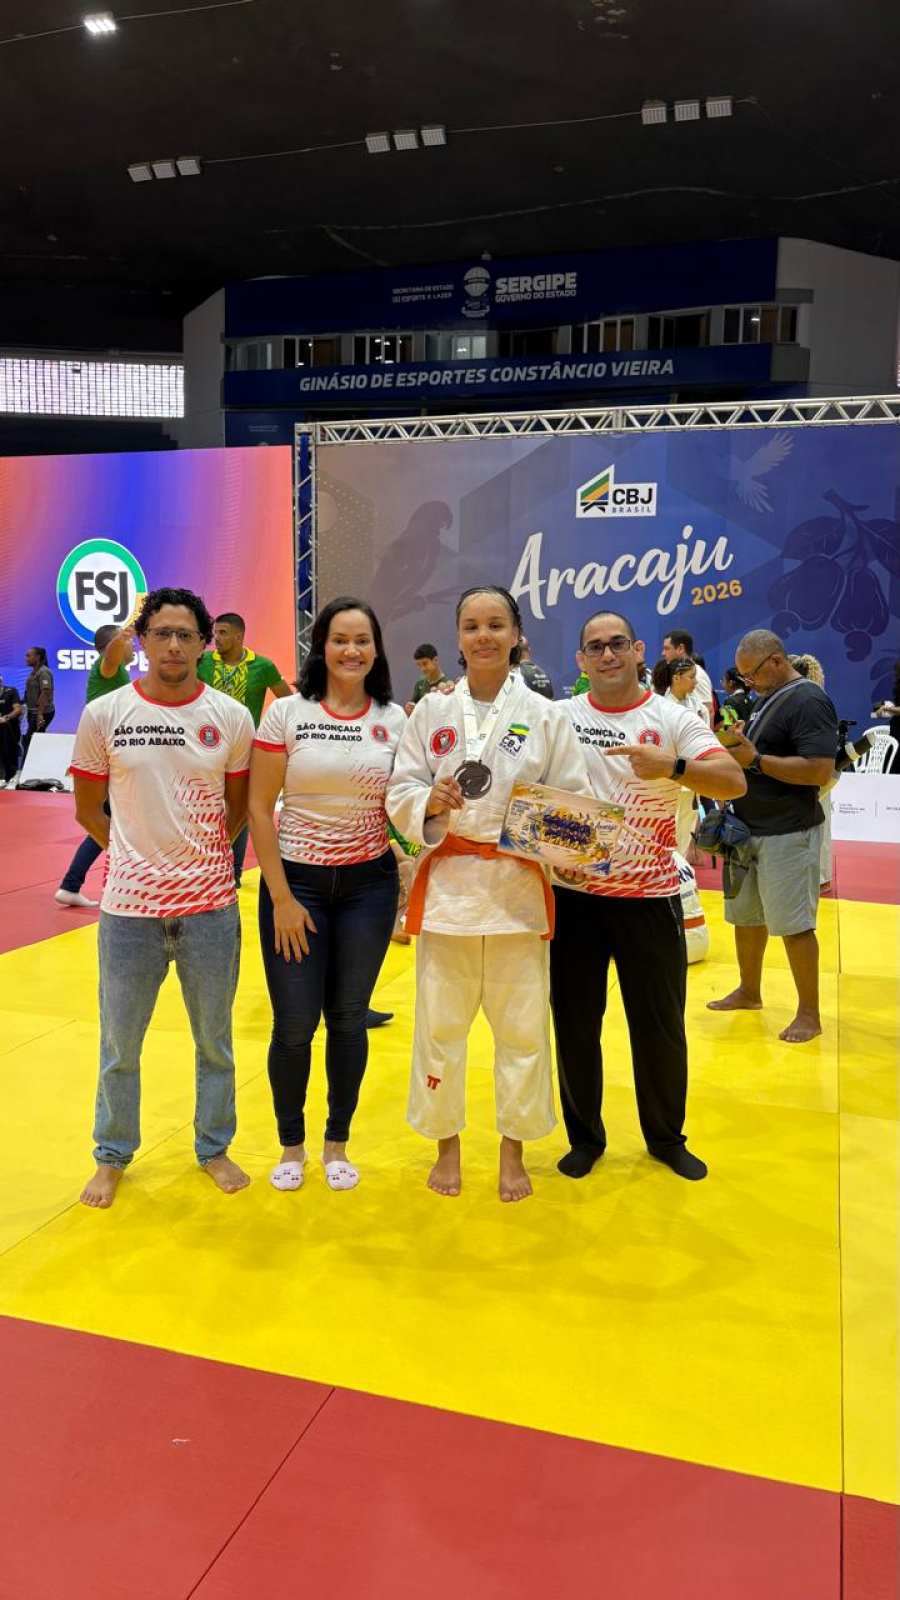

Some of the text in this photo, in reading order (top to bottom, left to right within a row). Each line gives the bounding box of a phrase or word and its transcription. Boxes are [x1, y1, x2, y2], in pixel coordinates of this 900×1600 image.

[495, 272, 577, 294] SERGIPE
[495, 289, 577, 303] GOVERNO DO ESTADO
[300, 359, 675, 391] GINÁSIO DE ESPORTES CONSTÂNCIO VIEIRA
[612, 488, 653, 505] CBJ
[510, 525, 734, 619] Aracaju
[75, 571, 130, 623] FSJ
[691, 579, 742, 606] 2026
[114, 725, 185, 736] SÃO GONÇALO
[297, 723, 361, 732] SÃO GONÇALO
[114, 738, 186, 747] DO RIO ABAIXO
[295, 733, 309, 741] DO
